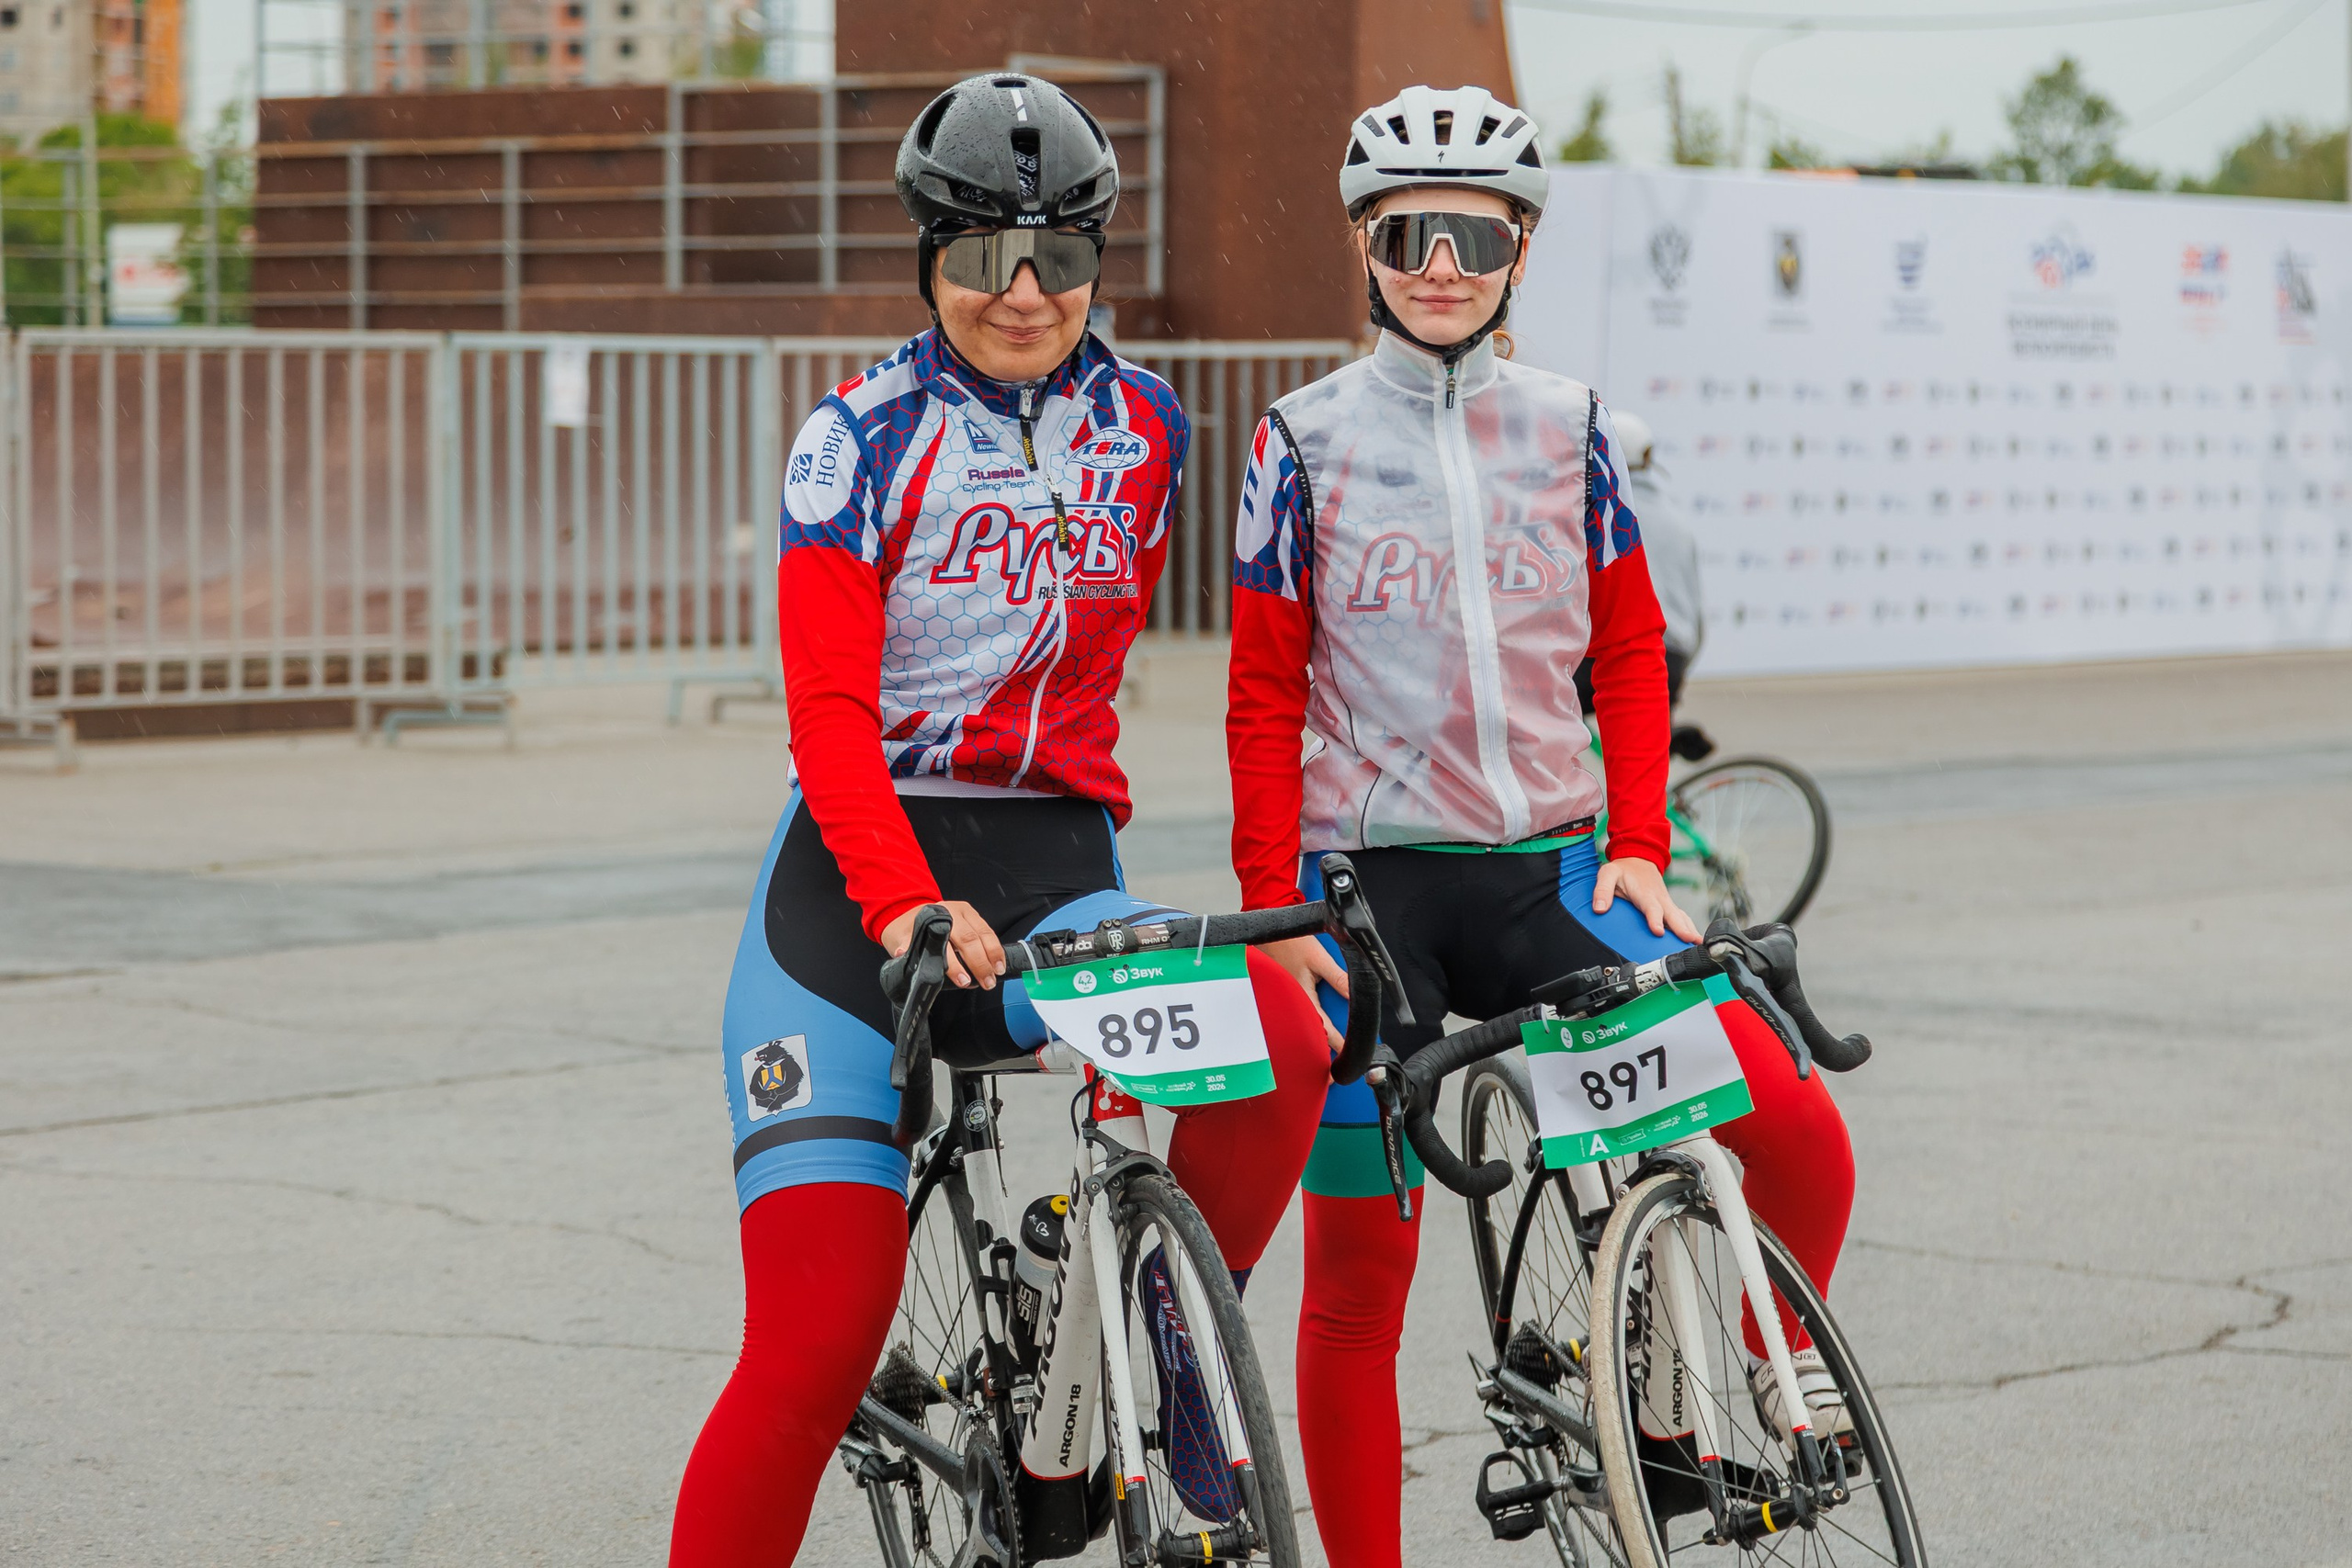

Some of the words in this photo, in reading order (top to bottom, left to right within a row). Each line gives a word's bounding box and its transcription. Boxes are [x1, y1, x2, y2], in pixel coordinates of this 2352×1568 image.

[1017, 215, 1046, 225] KASK
[1082, 441, 1140, 456] TERA
[962, 481, 1002, 494] Cycling
[1002, 479, 1035, 490] Team
[1088, 584, 1126, 599] CYCLING
[1130, 967, 1164, 980] Звук
[1098, 1003, 1201, 1058] 895
[1596, 1021, 1628, 1040] Звук
[1205, 1074, 1227, 1084] 30.05
[1580, 1044, 1667, 1111] 897
[1207, 1083, 1226, 1092] 2026
[1688, 1101, 1708, 1114] 30.05
[1690, 1110, 1709, 1122] 2026
[1672, 1367, 1683, 1427] ARGON
[1059, 1404, 1079, 1469] ARGON
[1069, 1383, 1082, 1403] 18
